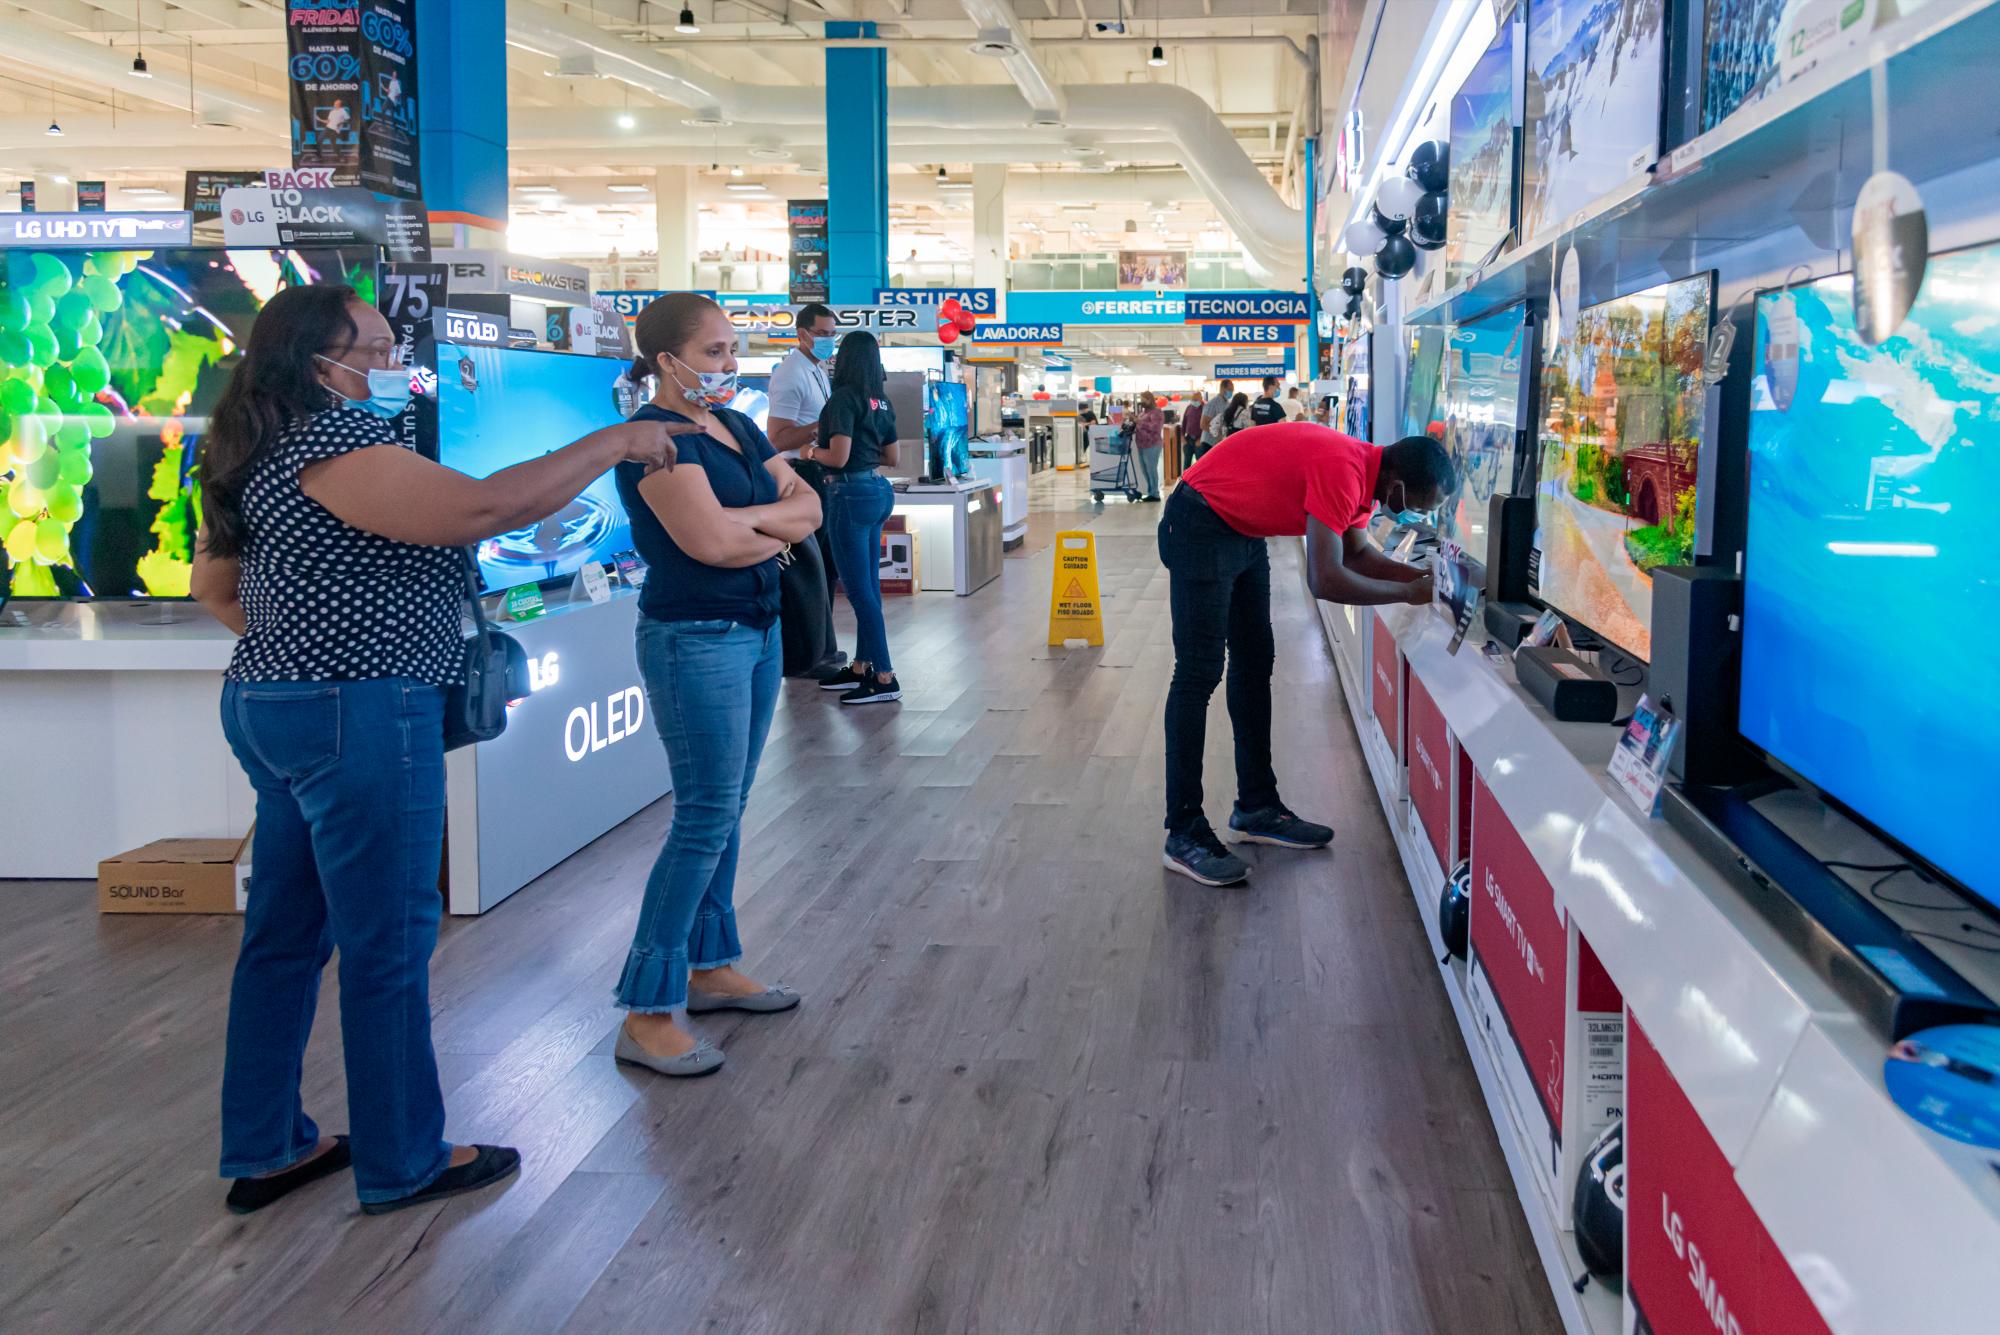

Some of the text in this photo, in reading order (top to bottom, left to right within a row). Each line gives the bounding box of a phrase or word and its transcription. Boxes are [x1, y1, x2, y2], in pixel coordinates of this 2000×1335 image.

[361, 11, 413, 57] 60%
[308, 45, 335, 53] HASTA
[289, 53, 361, 81] 60%
[305, 83, 359, 92] DE AHORRO
[268, 171, 330, 190] BACK
[272, 189, 302, 206] TO
[247, 211, 265, 223] LG
[275, 206, 344, 224] BLACK
[15, 221, 42, 238] LG
[46, 221, 87, 238] UHD
[385, 274, 442, 318] 75"
[1188, 299, 1308, 314] TECNOLOGIA
[446, 318, 499, 342] LG OLED
[973, 326, 1061, 340] LAVADORAS
[1216, 326, 1279, 341] AIRES
[1216, 366, 1284, 376] ENSERES MENORES
[526, 651, 560, 692] LG
[564, 685, 644, 762] OLED
[109, 884, 185, 900] SOUND Bar
[1485, 866, 1527, 959] LG SMART TV
[1662, 1191, 1684, 1260] LG
